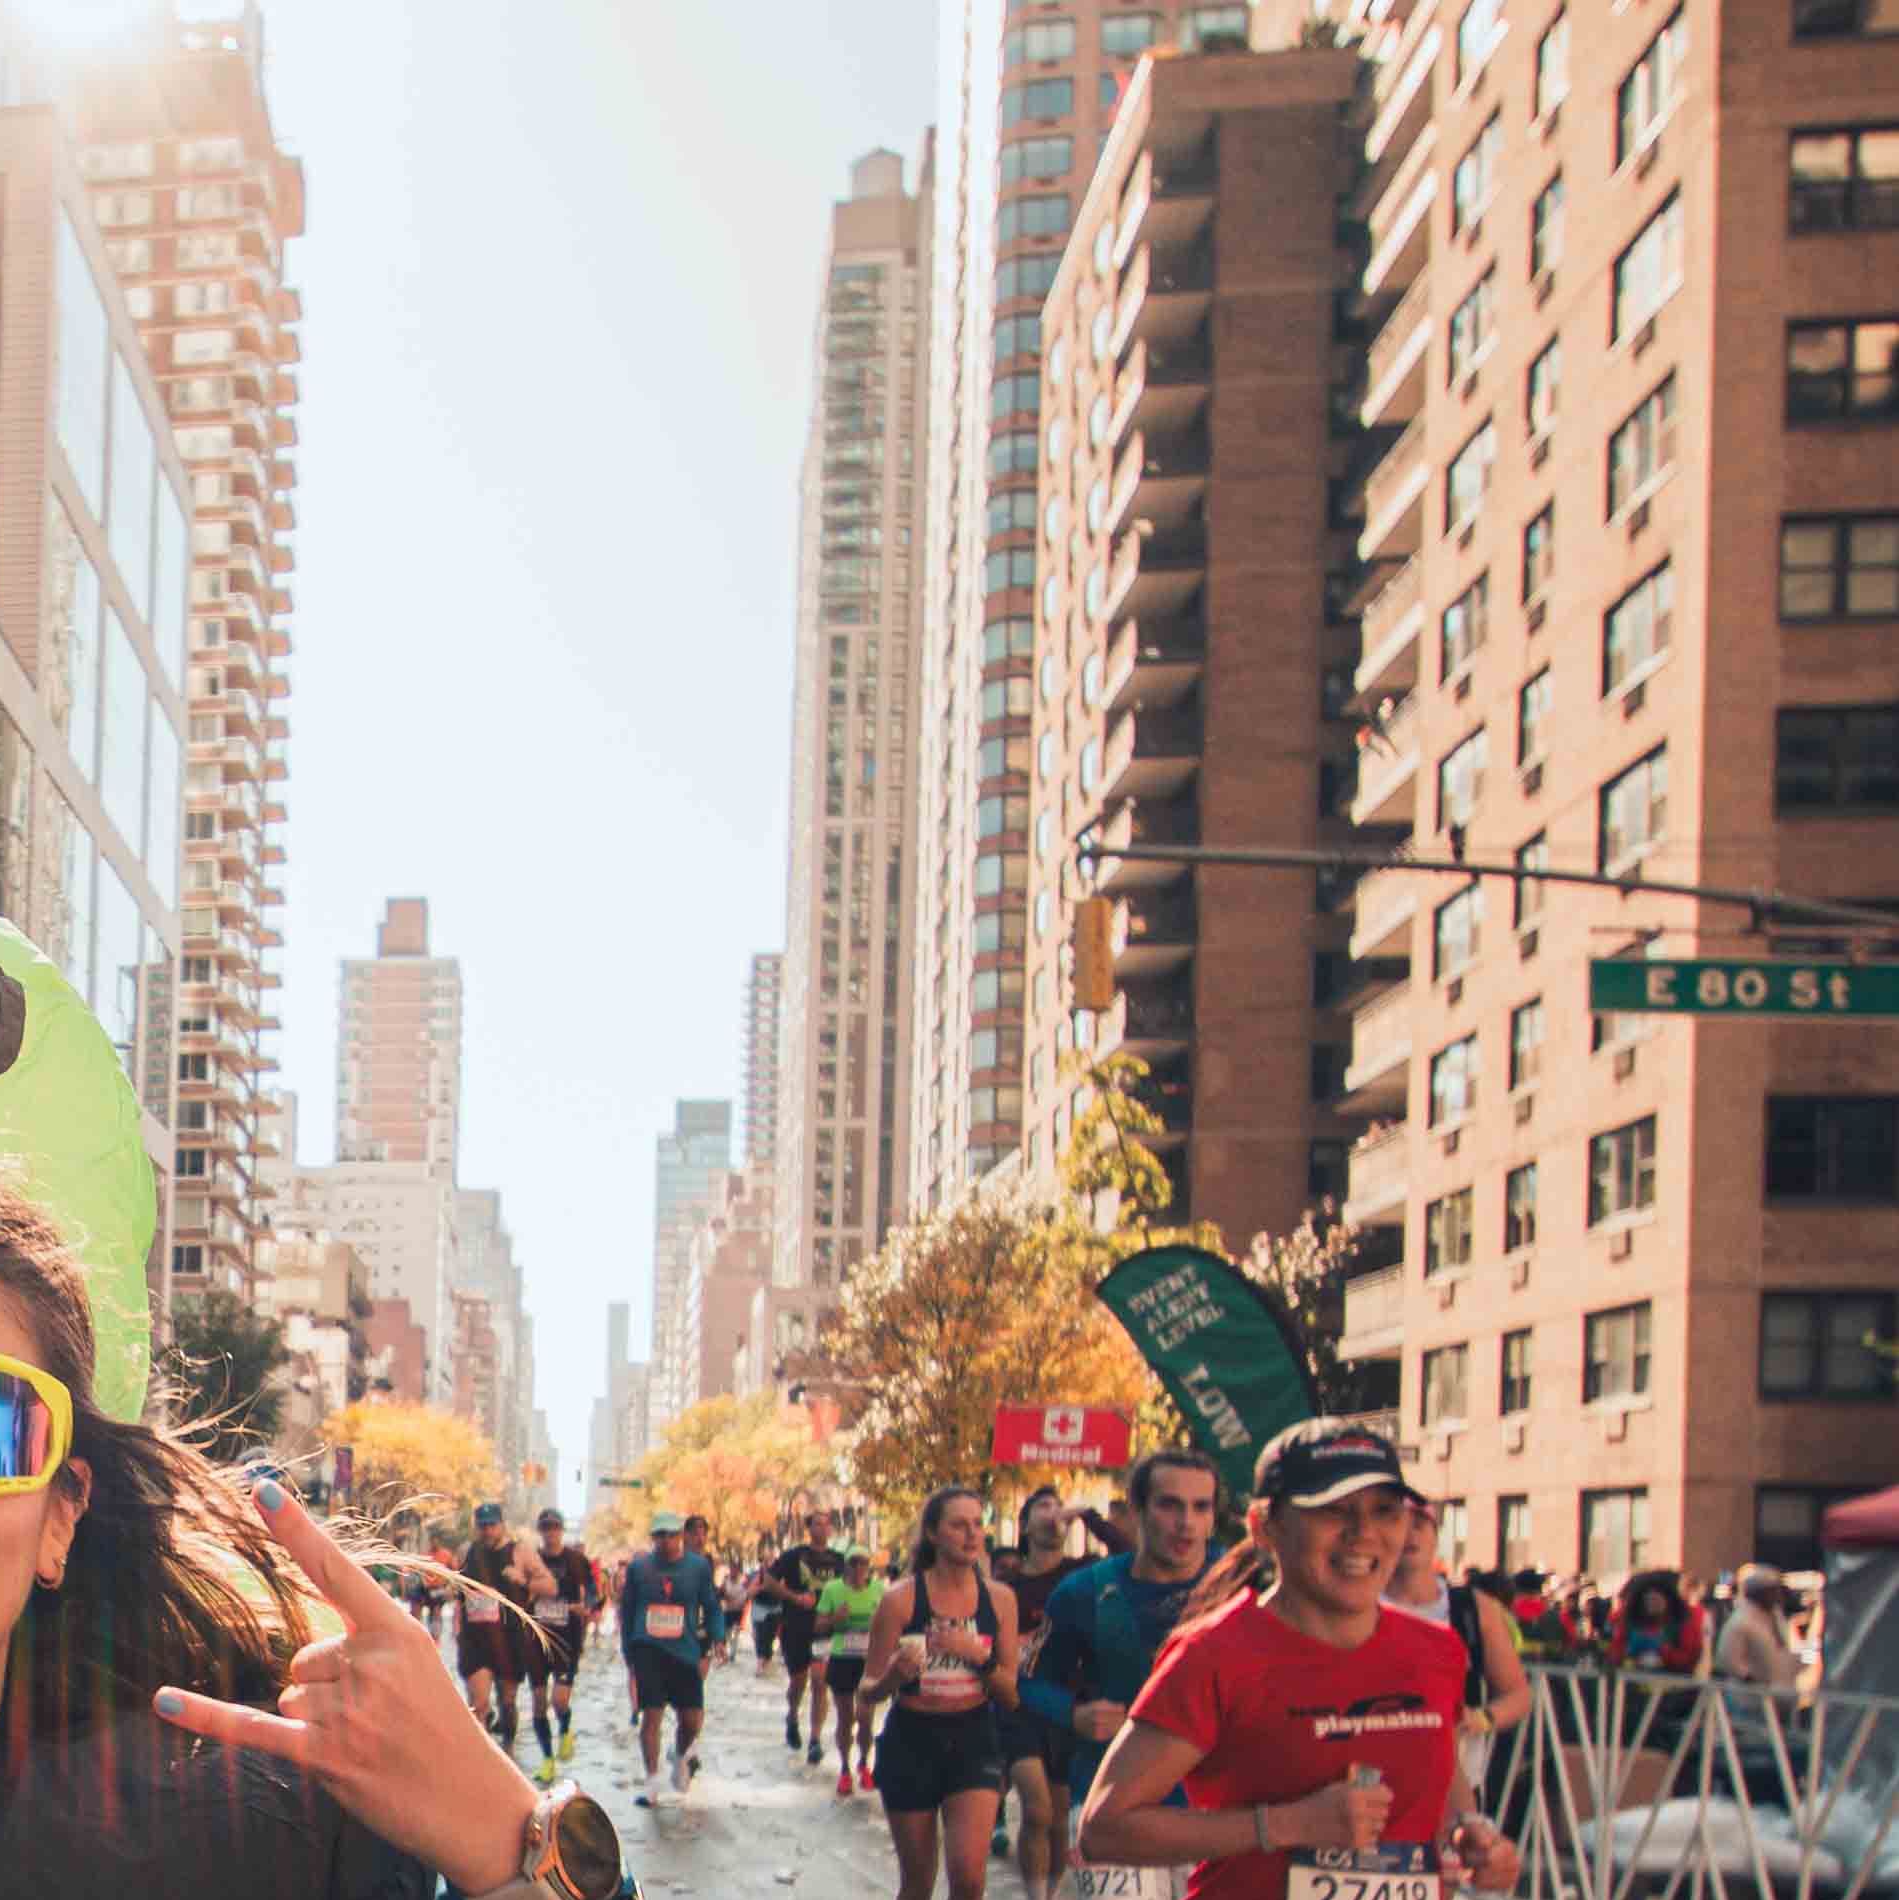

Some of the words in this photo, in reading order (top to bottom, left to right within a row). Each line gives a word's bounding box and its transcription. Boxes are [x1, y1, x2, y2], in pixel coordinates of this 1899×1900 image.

[1647, 967, 1677, 1006] E
[1697, 968, 1769, 1007] 80
[1790, 970, 1849, 1009] St
[1127, 1264, 1199, 1316] EVENT
[1147, 1280, 1210, 1335] ALERT
[1156, 1302, 1225, 1352] LEVEL
[1180, 1362, 1252, 1449] LOW
[1021, 1442, 1102, 1463] Medical
